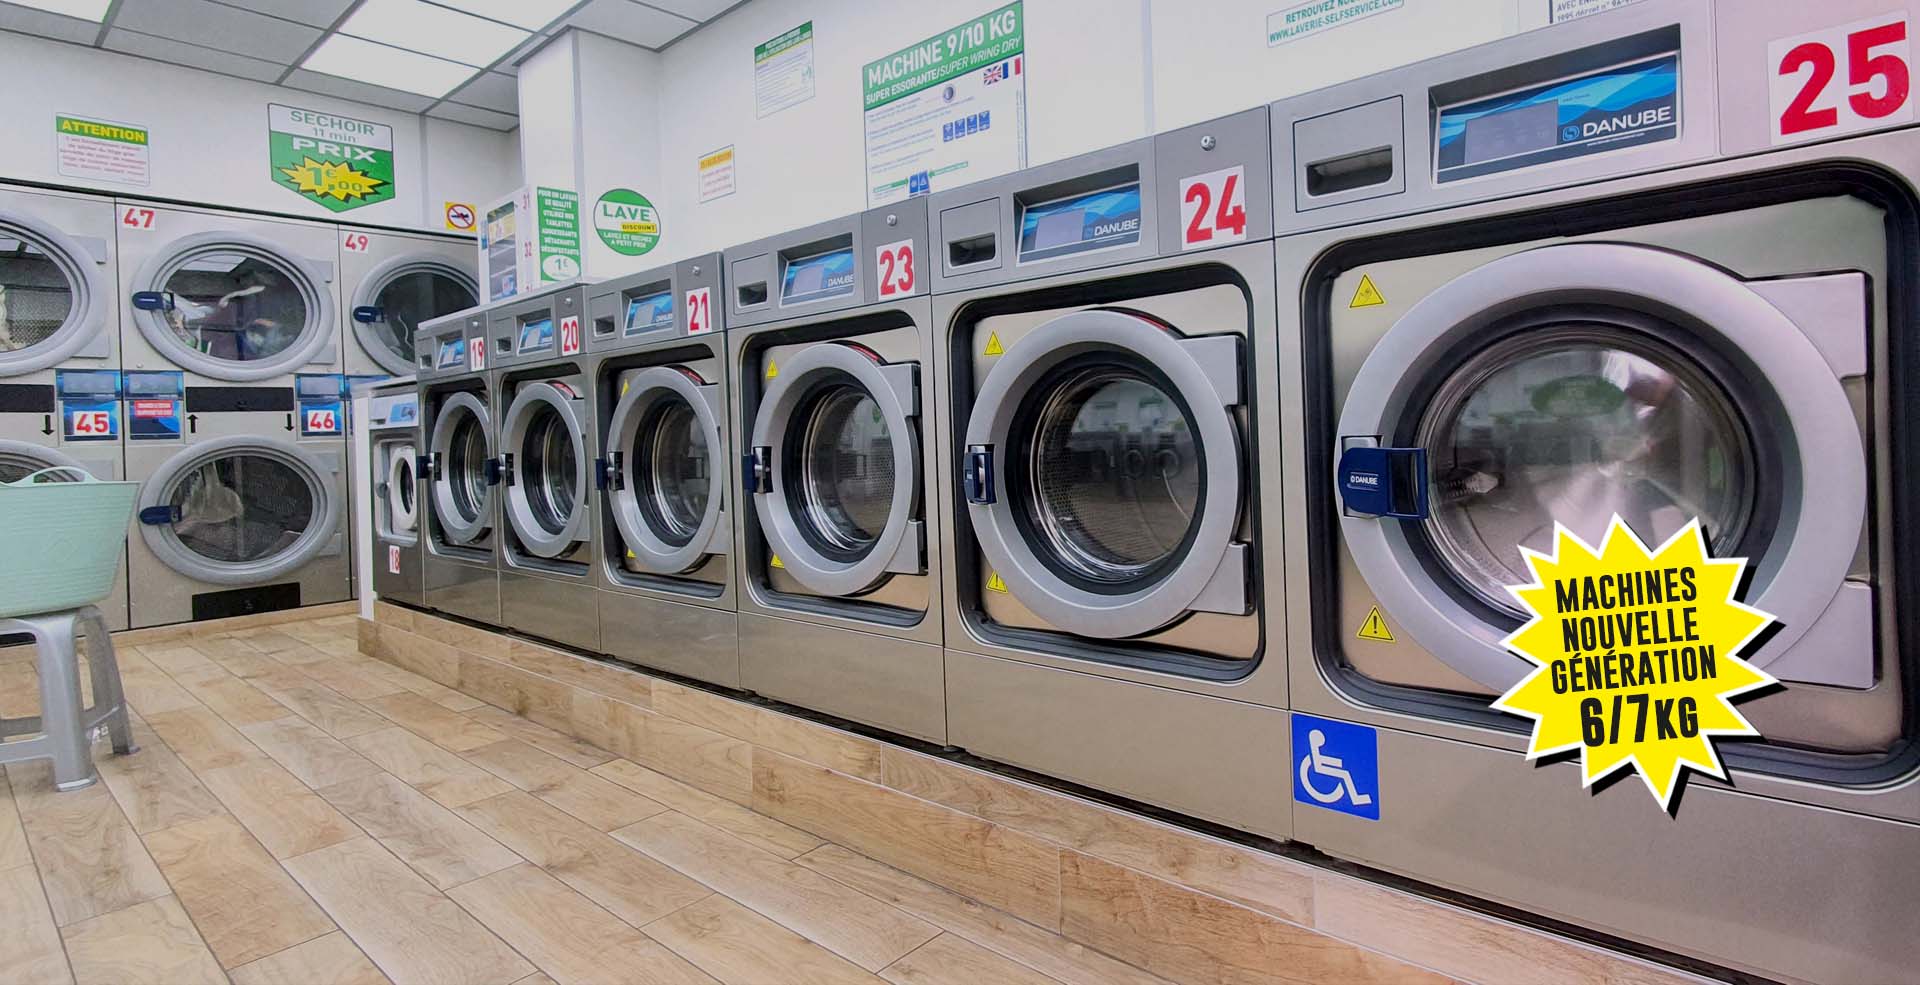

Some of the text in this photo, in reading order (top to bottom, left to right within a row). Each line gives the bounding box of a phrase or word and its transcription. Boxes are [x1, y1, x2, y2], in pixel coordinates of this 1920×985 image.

[1286, 0, 1335, 24] RETROUVEZ
[868, 9, 1016, 88] MACHINE 9/10 KG
[865, 85, 890, 105] SUPER
[970, 44, 1000, 64] WRING
[1001, 36, 1022, 53] DRY
[1778, 20, 1910, 136] 25
[62, 119, 145, 143] ATTENTION
[290, 110, 375, 137] SECHOIR
[1583, 106, 1671, 137] DANUBE
[313, 127, 357, 144] 11 min
[292, 137, 377, 164] PRIX
[123, 208, 155, 228] 47
[603, 204, 651, 222] LAVE
[1185, 174, 1246, 244] 24
[622, 224, 655, 233] DISCOUNT
[1094, 218, 1139, 237] DANUBE
[345, 233, 369, 251] 49
[879, 244, 914, 296] 23
[688, 291, 709, 331] 21
[563, 318, 579, 352] 20
[471, 340, 484, 369] 19
[76, 413, 109, 433] 45
[309, 412, 335, 430] 46
[1355, 475, 1379, 486] DANUBE
